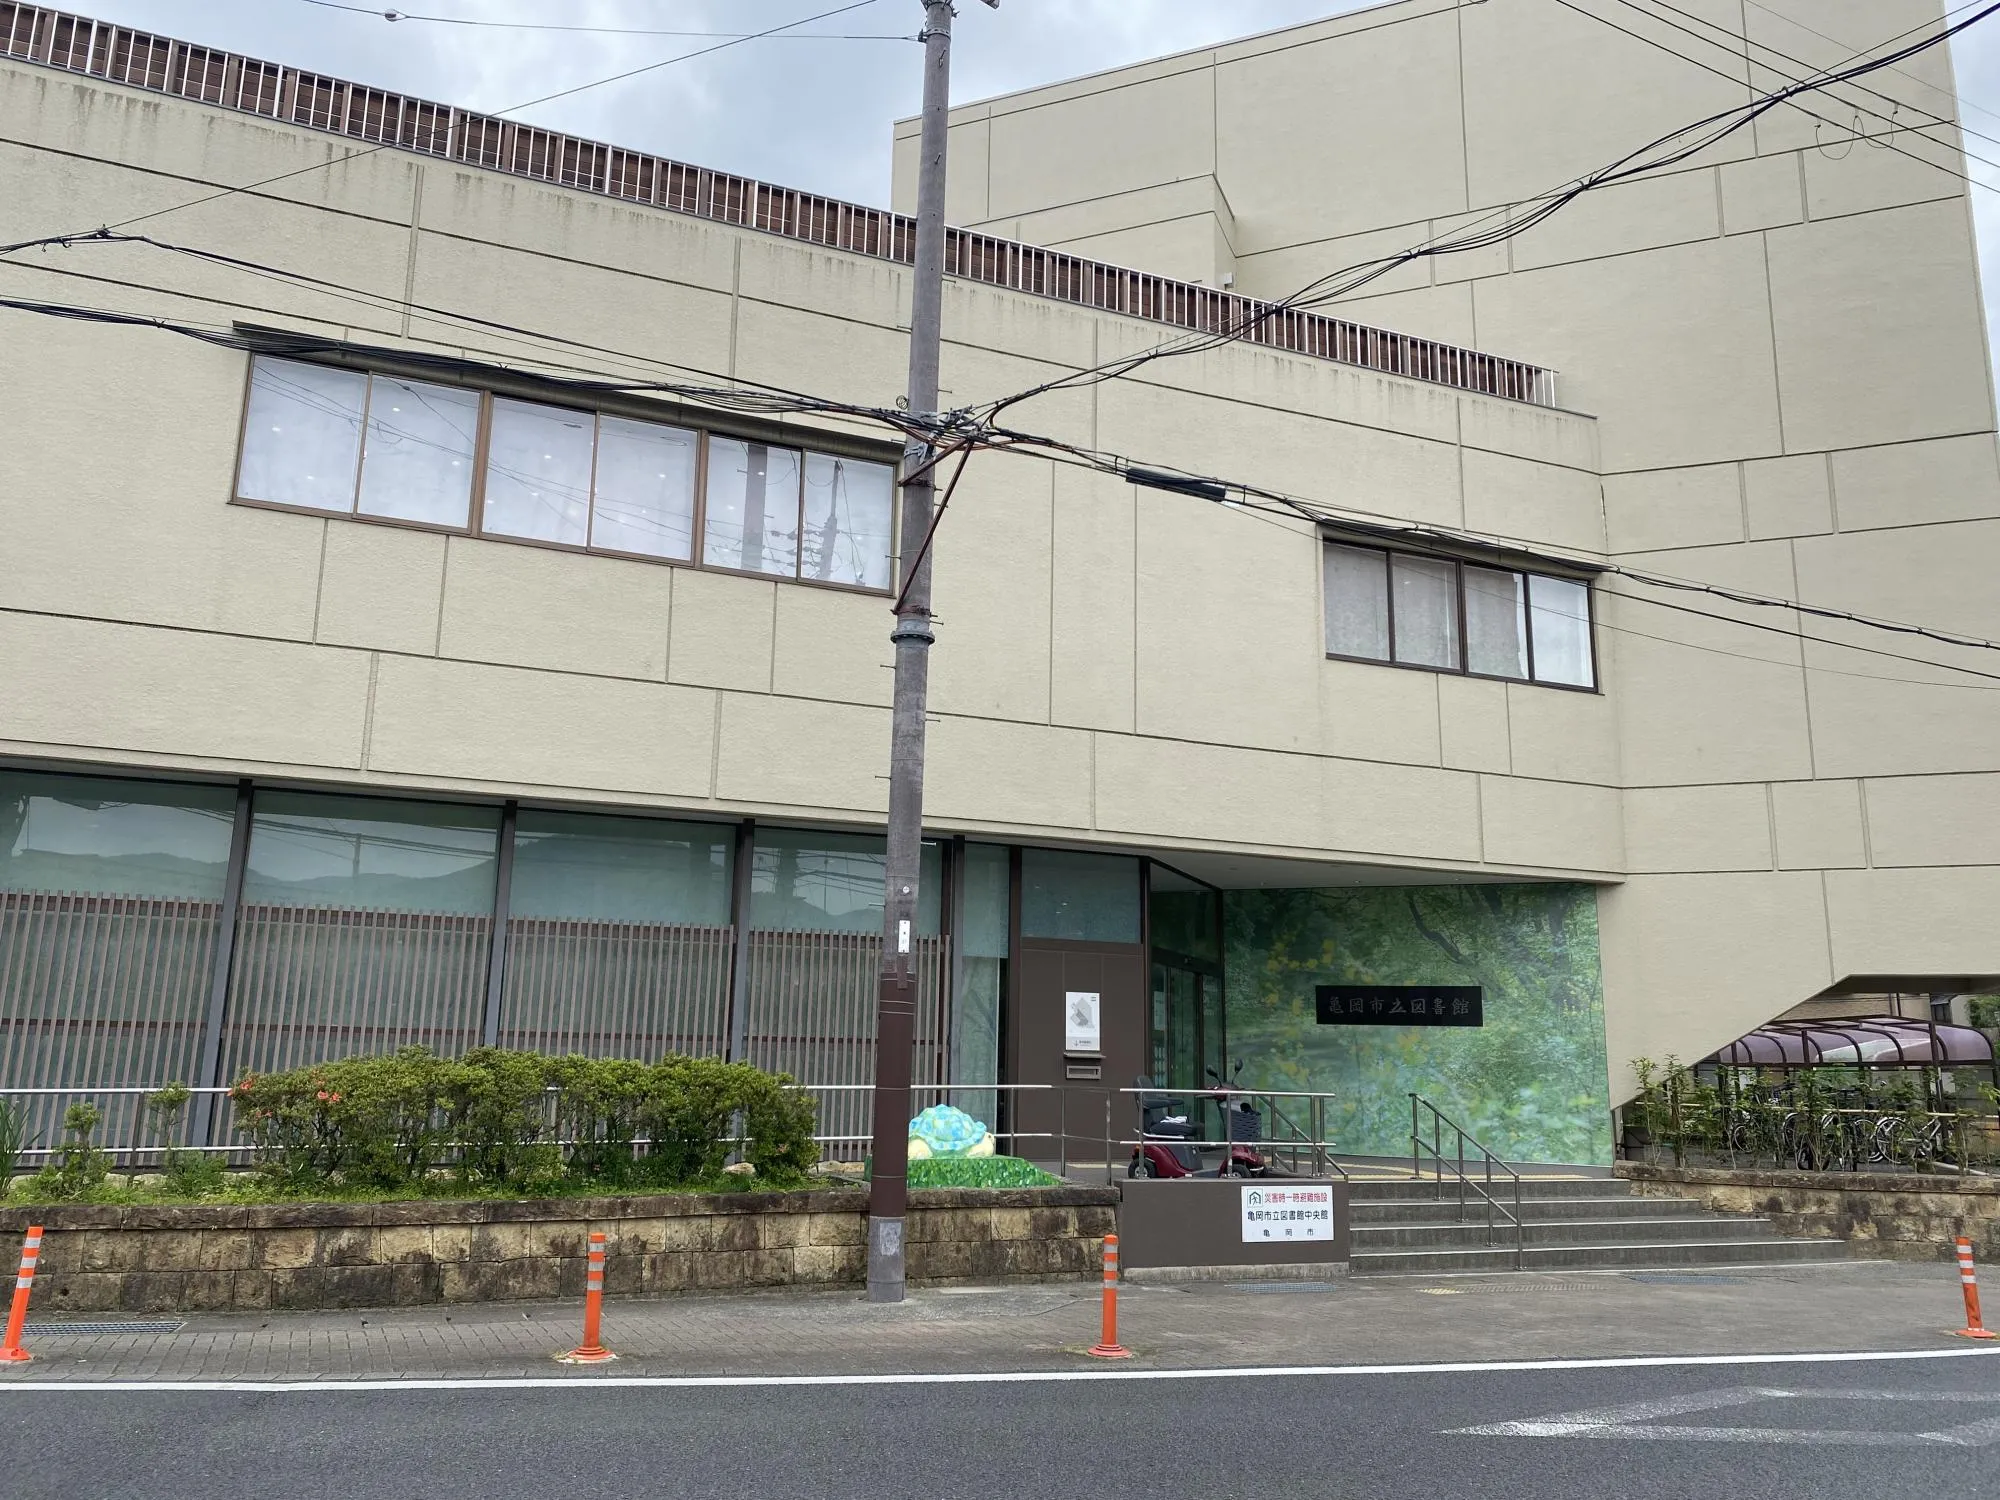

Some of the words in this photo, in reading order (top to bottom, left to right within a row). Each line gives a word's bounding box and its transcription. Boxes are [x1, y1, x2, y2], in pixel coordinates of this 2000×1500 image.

[1328, 996, 1471, 1015] 亀岡市立図書館
[1264, 1192, 1327, 1203] 災害時一時避難施設
[1247, 1210, 1328, 1221] 亀岡市立図書館中央館
